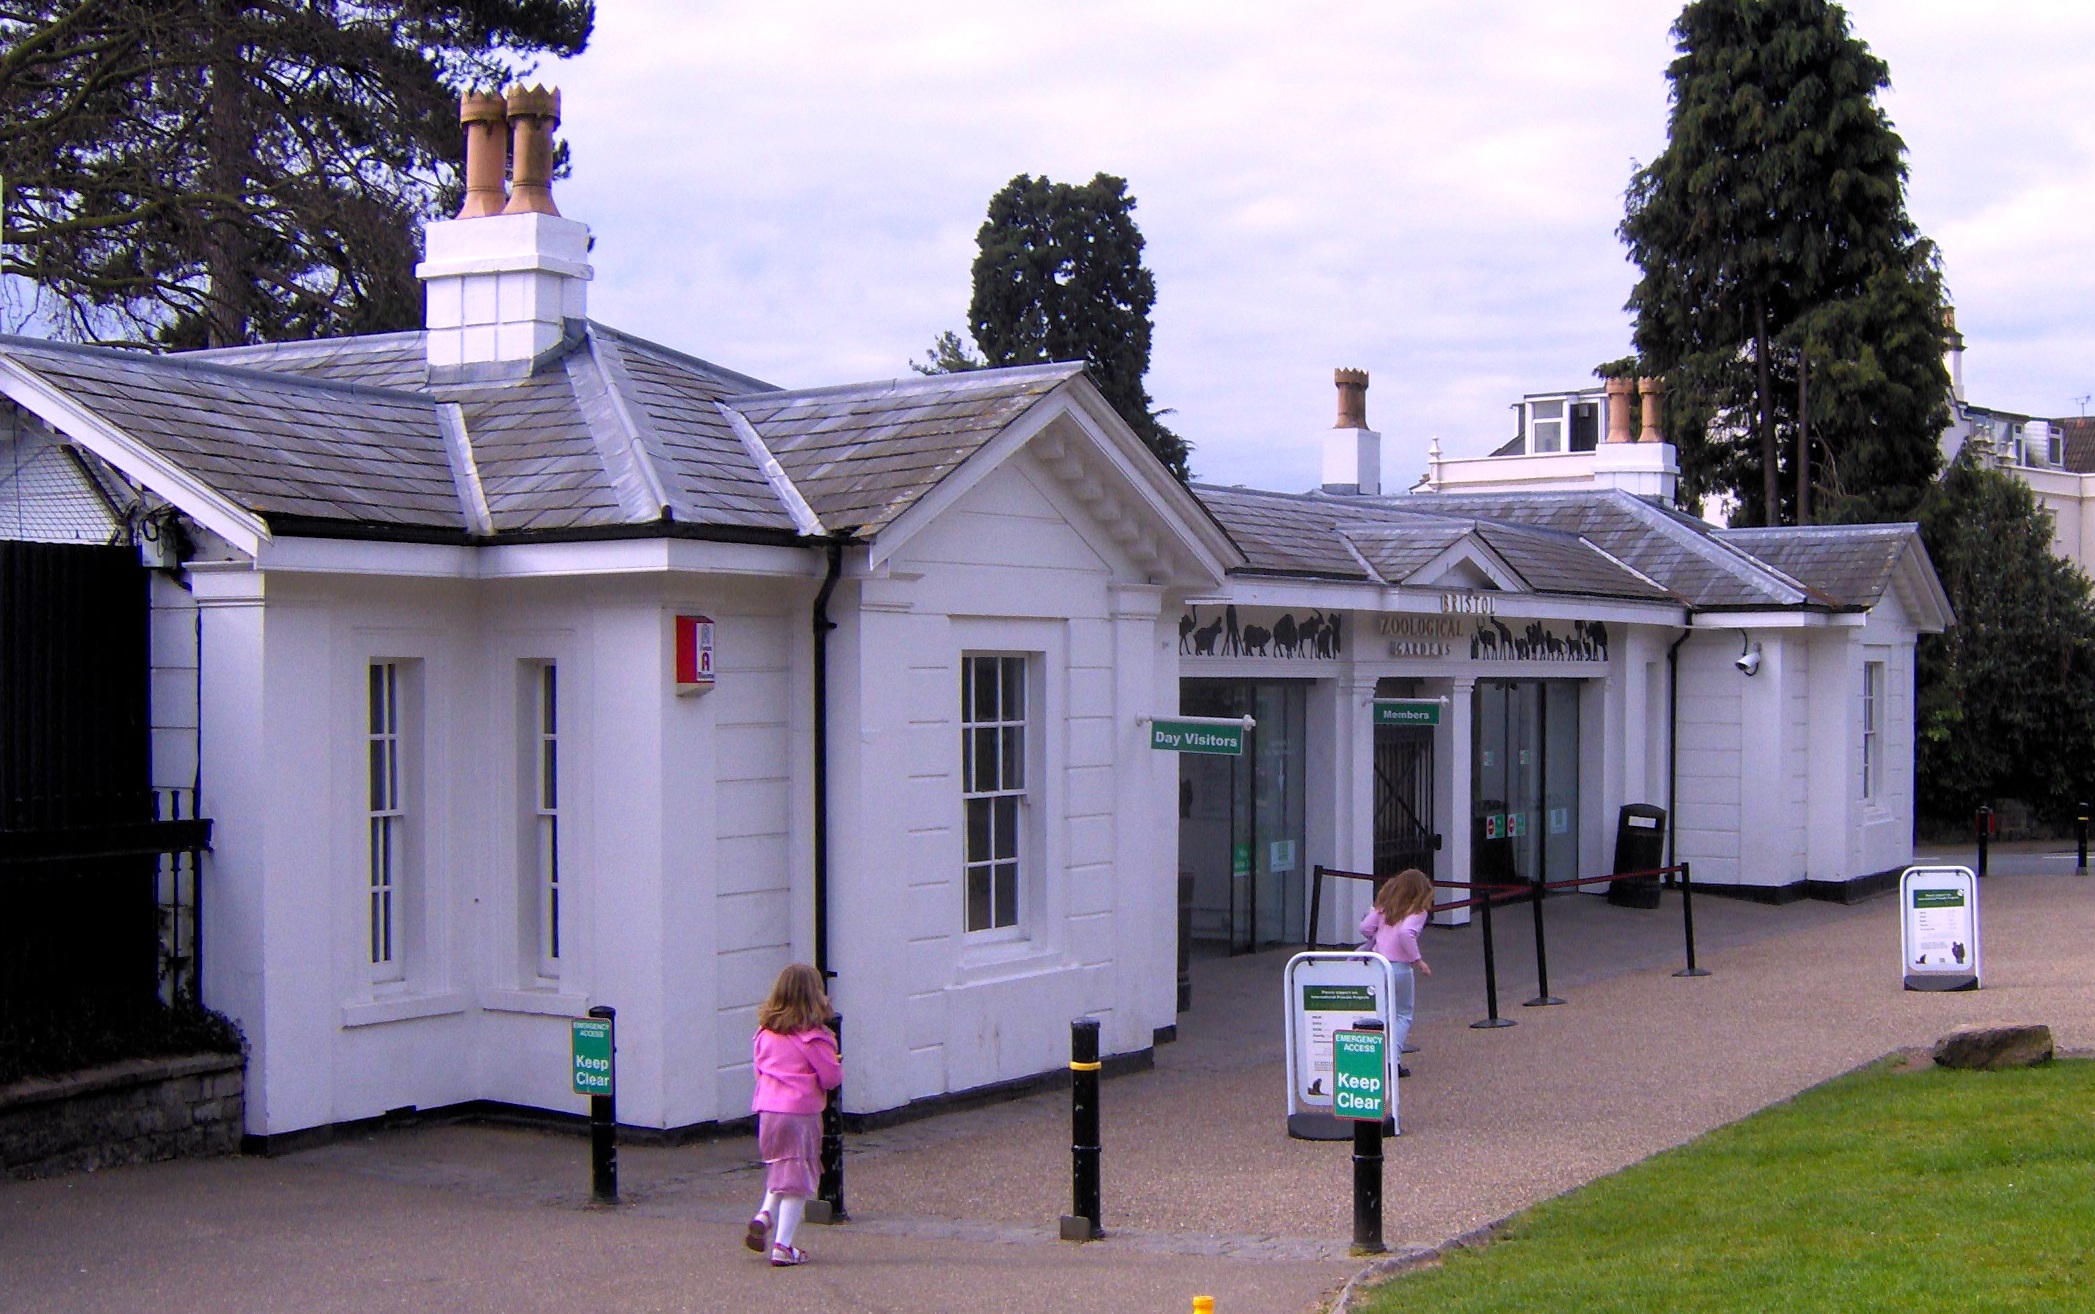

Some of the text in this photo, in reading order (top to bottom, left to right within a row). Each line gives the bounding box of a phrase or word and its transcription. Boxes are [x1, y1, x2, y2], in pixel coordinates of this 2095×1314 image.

[1440, 594, 1495, 614] BRISTOL
[1381, 616, 1463, 637] ZOOLOGICAL
[1394, 641, 1451, 655] GARDENS
[1383, 710, 1430, 719] Members
[1155, 731, 1238, 747] Day Visitors
[1335, 1034, 1383, 1044] EMERGENCY
[1344, 1043, 1376, 1052] ACCESS
[576, 1055, 609, 1071] Keep
[576, 1072, 609, 1086] Clear
[1337, 1072, 1380, 1093] Keep
[1337, 1092, 1381, 1110] Clear
